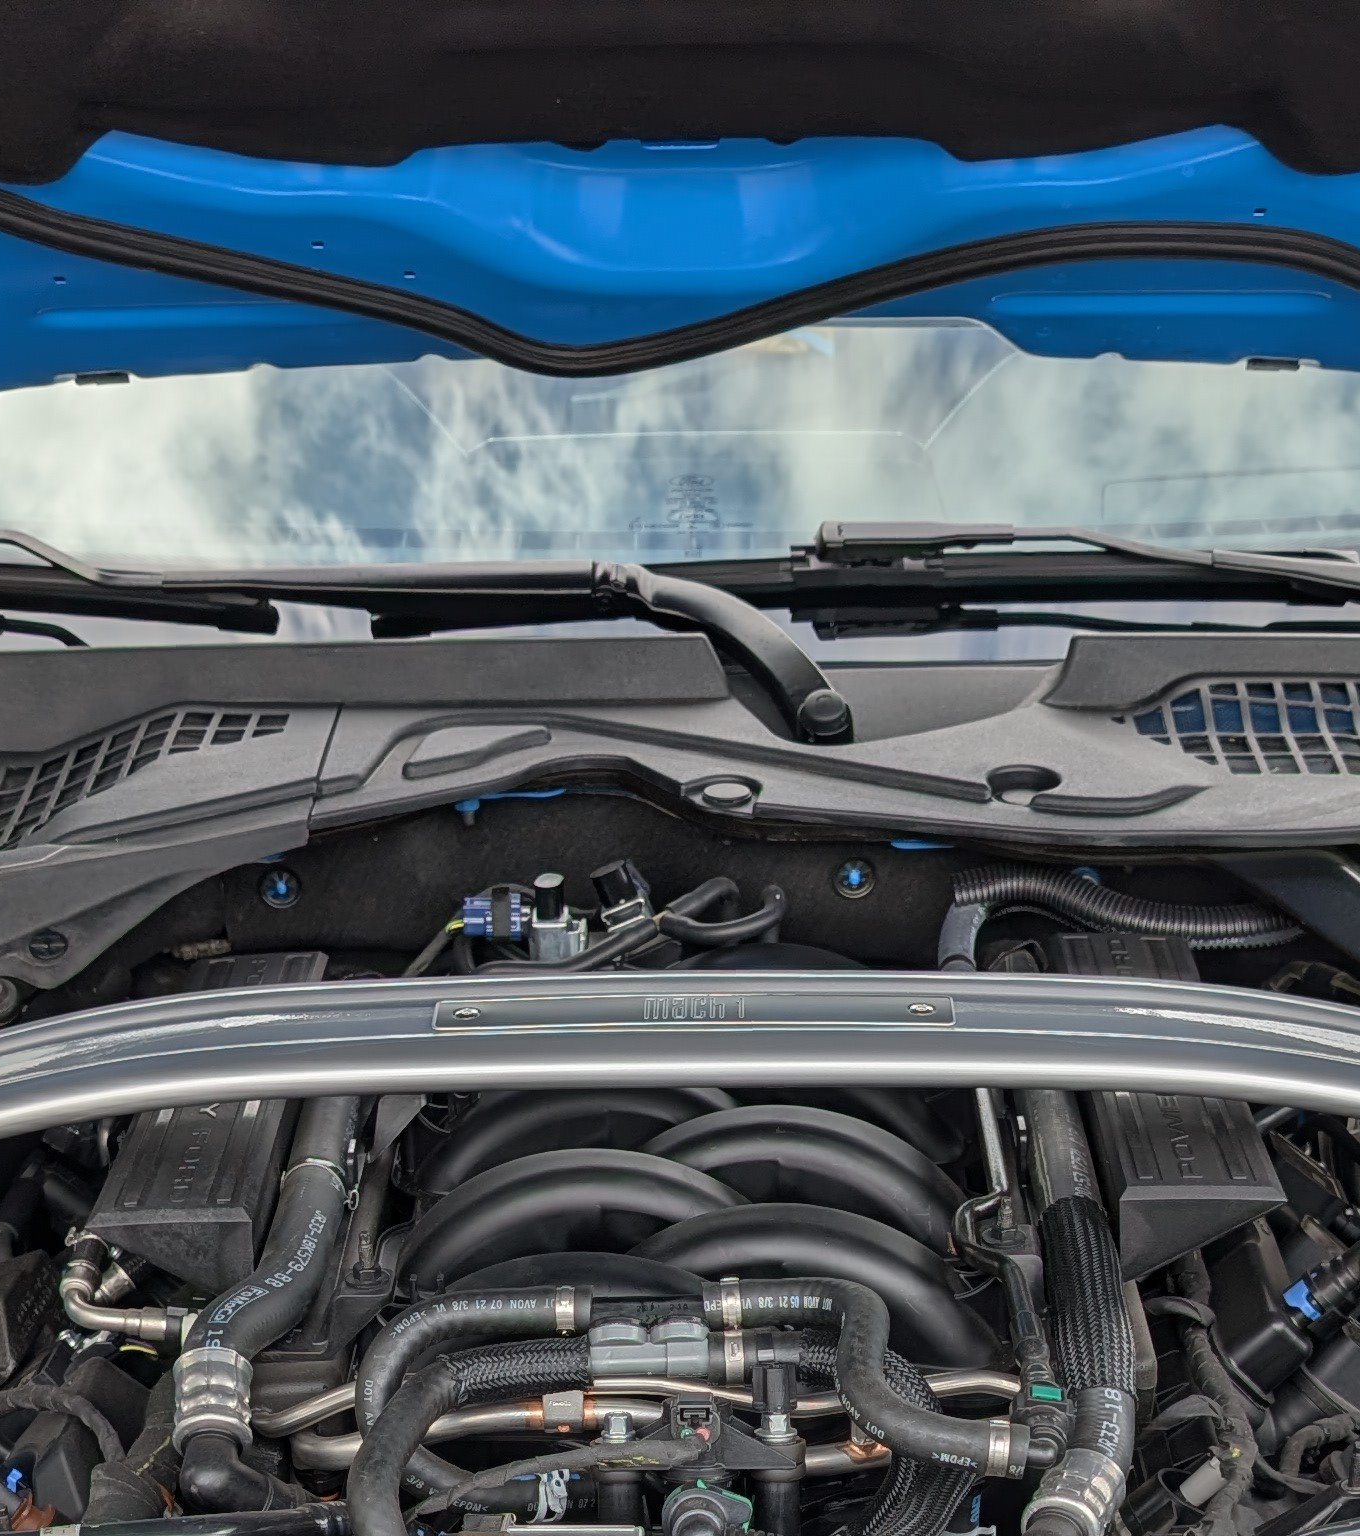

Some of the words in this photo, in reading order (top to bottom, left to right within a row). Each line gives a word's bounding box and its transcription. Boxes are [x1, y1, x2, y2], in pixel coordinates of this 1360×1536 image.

[736, 996, 746, 1020] 1
[432, 1302, 446, 1313] VL
[451, 1299, 469, 1311] 3/8
[474, 1299, 487, 1311] 21
[488, 1298, 502, 1310] 07
[509, 1298, 537, 1310] AVON
[757, 1296, 774, 1309] 3/8
[362, 1378, 375, 1404] DOT
[863, 1420, 885, 1440] DOT
[1096, 1387, 1124, 1458] JR33-18
[930, 1450, 978, 1469] >EPDM<
[406, 1474, 425, 1490] 3/8
[452, 1497, 489, 1513] EPDM<
